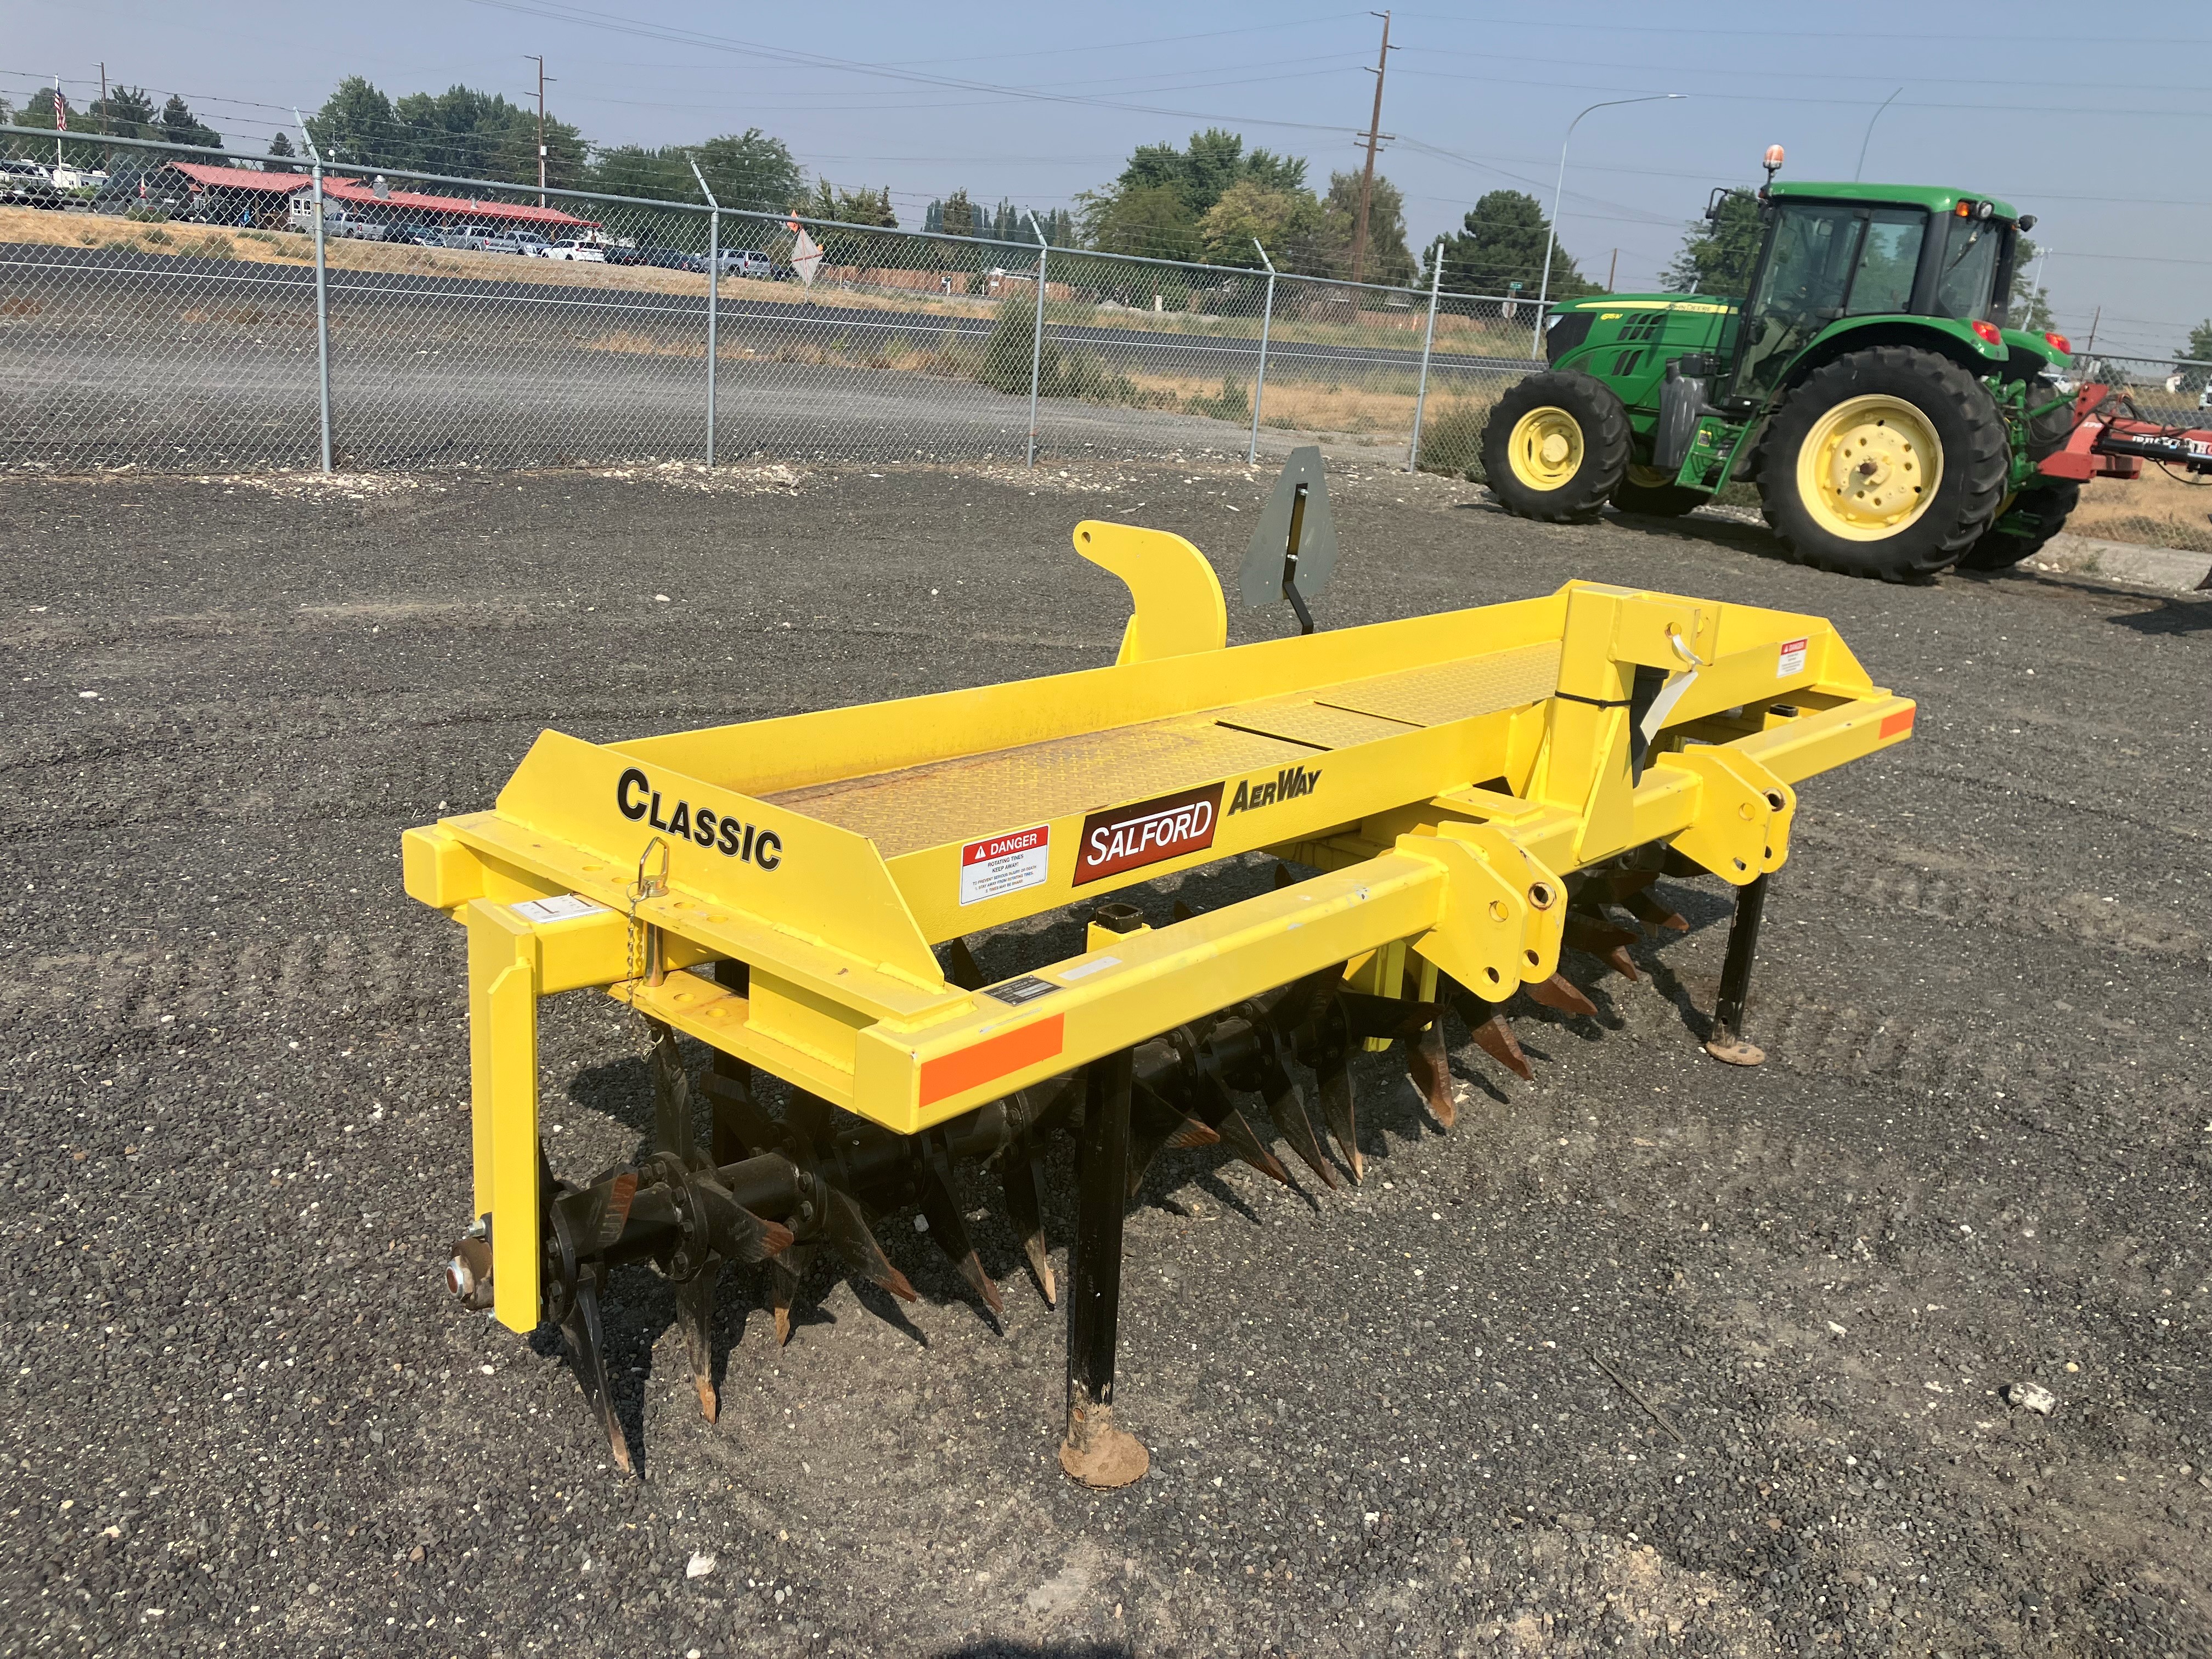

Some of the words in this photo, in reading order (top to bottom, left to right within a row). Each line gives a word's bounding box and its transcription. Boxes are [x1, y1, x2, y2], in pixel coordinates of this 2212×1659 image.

[617, 766, 783, 872] CLASSIC
[990, 833, 1037, 855] DANGER
[1087, 800, 1212, 866] SALFORD
[988, 857, 1010, 867] ROTATING
[1005, 862, 1019, 870] AWAY!
